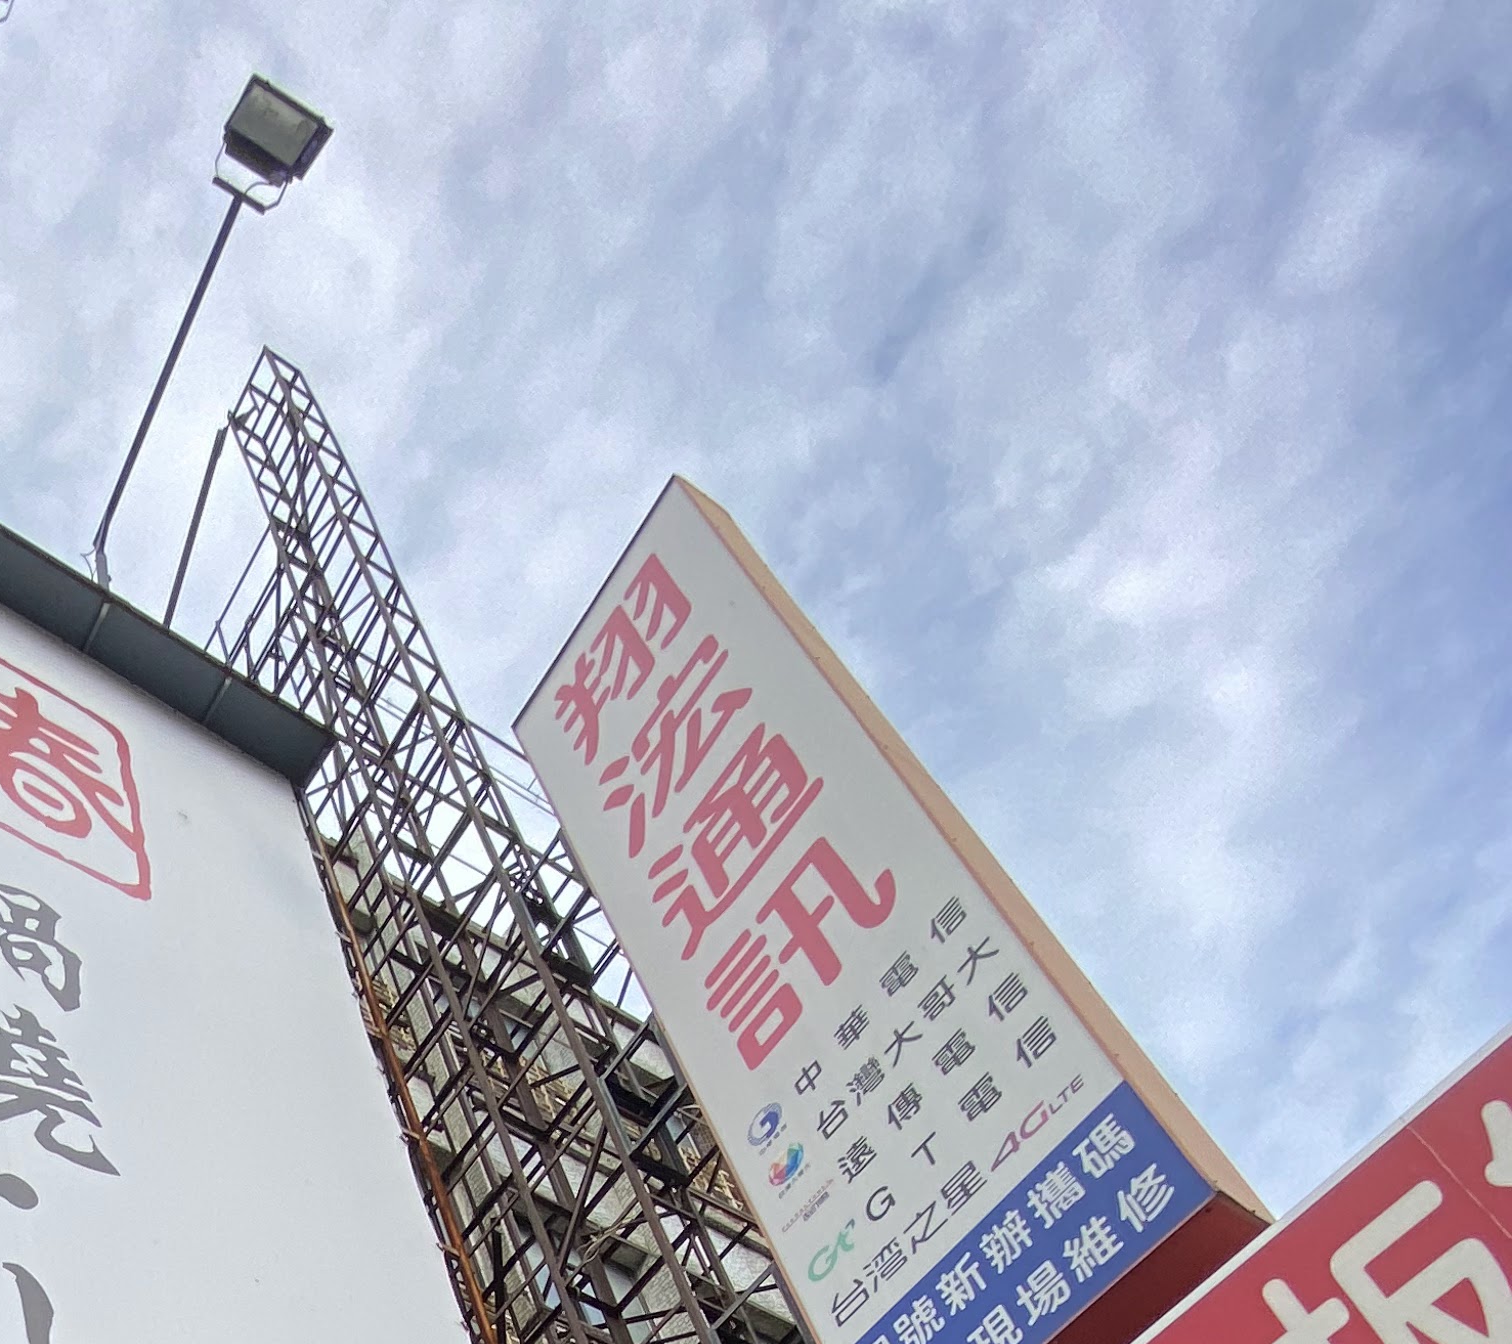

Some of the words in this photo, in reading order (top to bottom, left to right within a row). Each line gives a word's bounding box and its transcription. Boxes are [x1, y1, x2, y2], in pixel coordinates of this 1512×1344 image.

[793, 895, 969, 1098] 中華電信
[815, 936, 1000, 1140] 台灣大哥大
[836, 972, 1029, 1185] 遠傳電信
